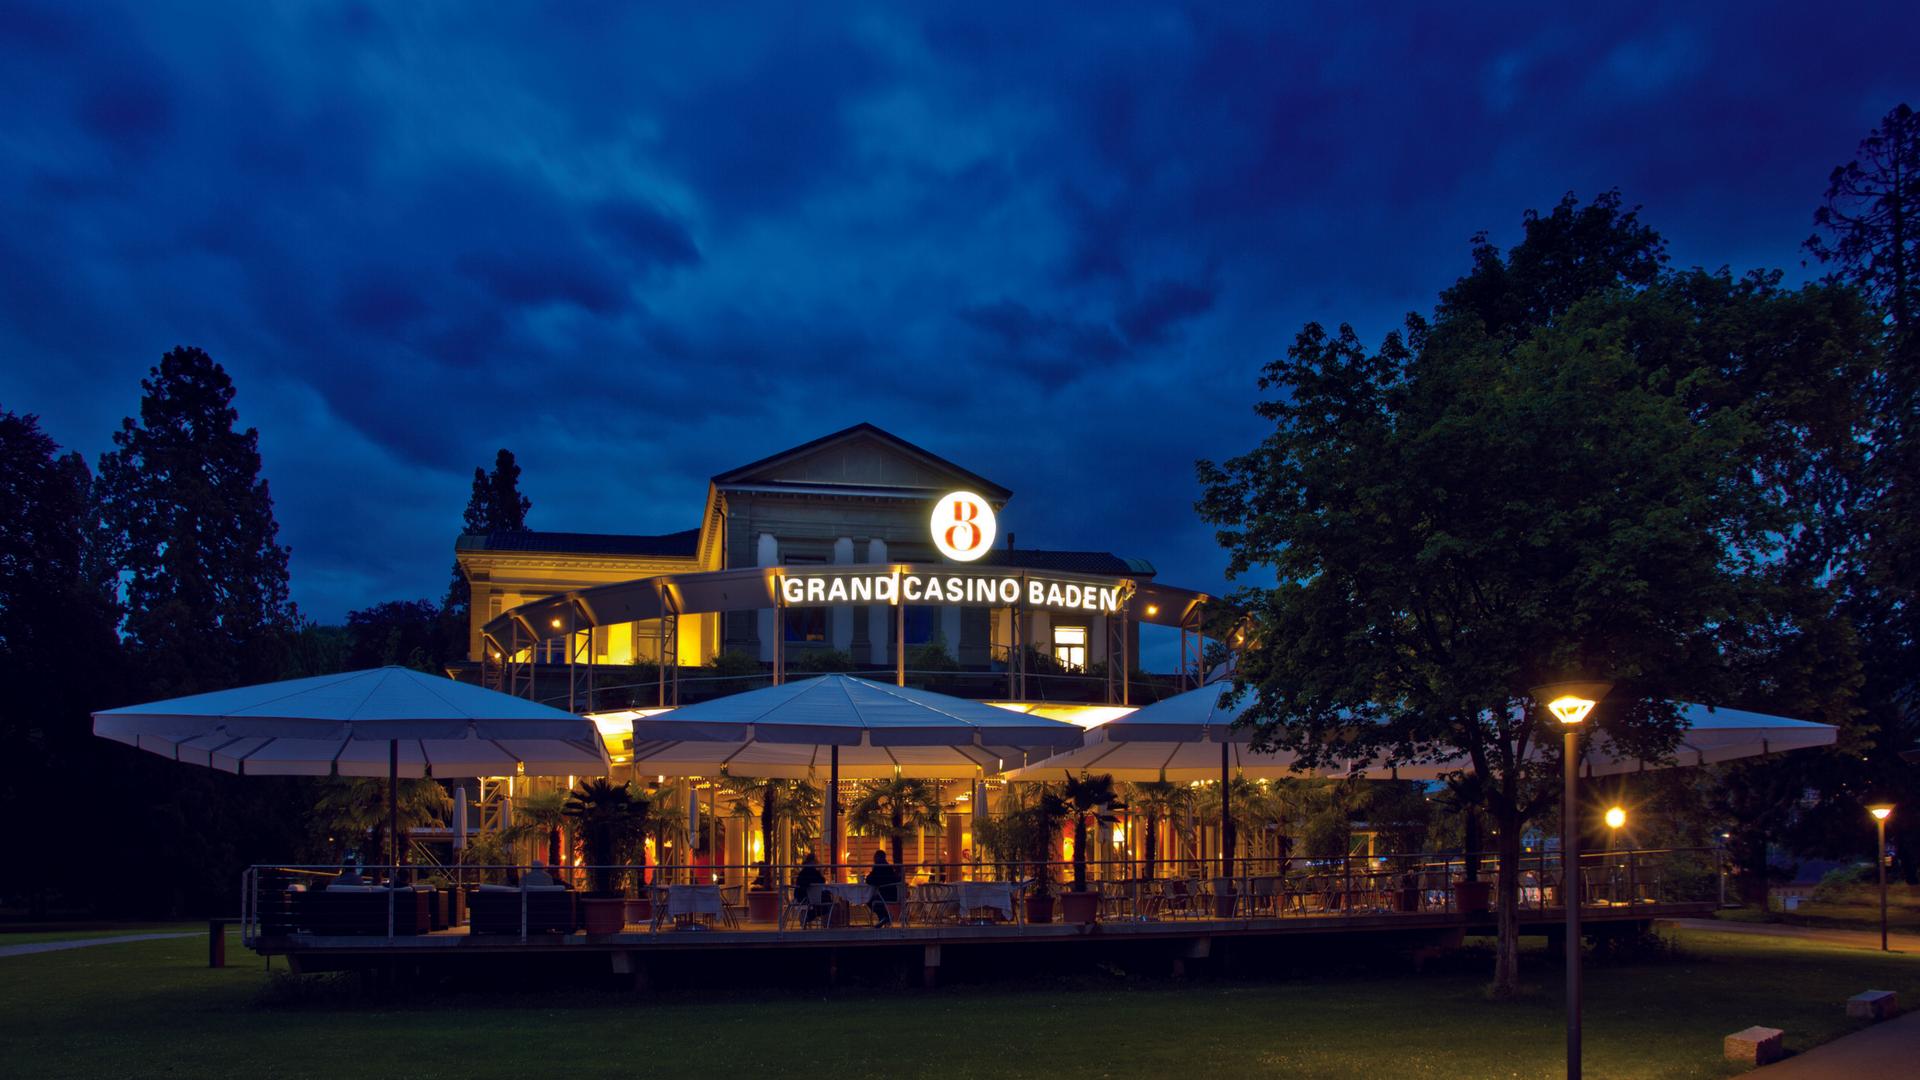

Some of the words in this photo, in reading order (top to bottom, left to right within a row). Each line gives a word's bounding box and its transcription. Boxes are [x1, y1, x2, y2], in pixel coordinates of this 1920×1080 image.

[783, 576, 892, 602] GRAND
[903, 576, 1020, 603] CASINO
[1029, 579, 1119, 611] BADEN
